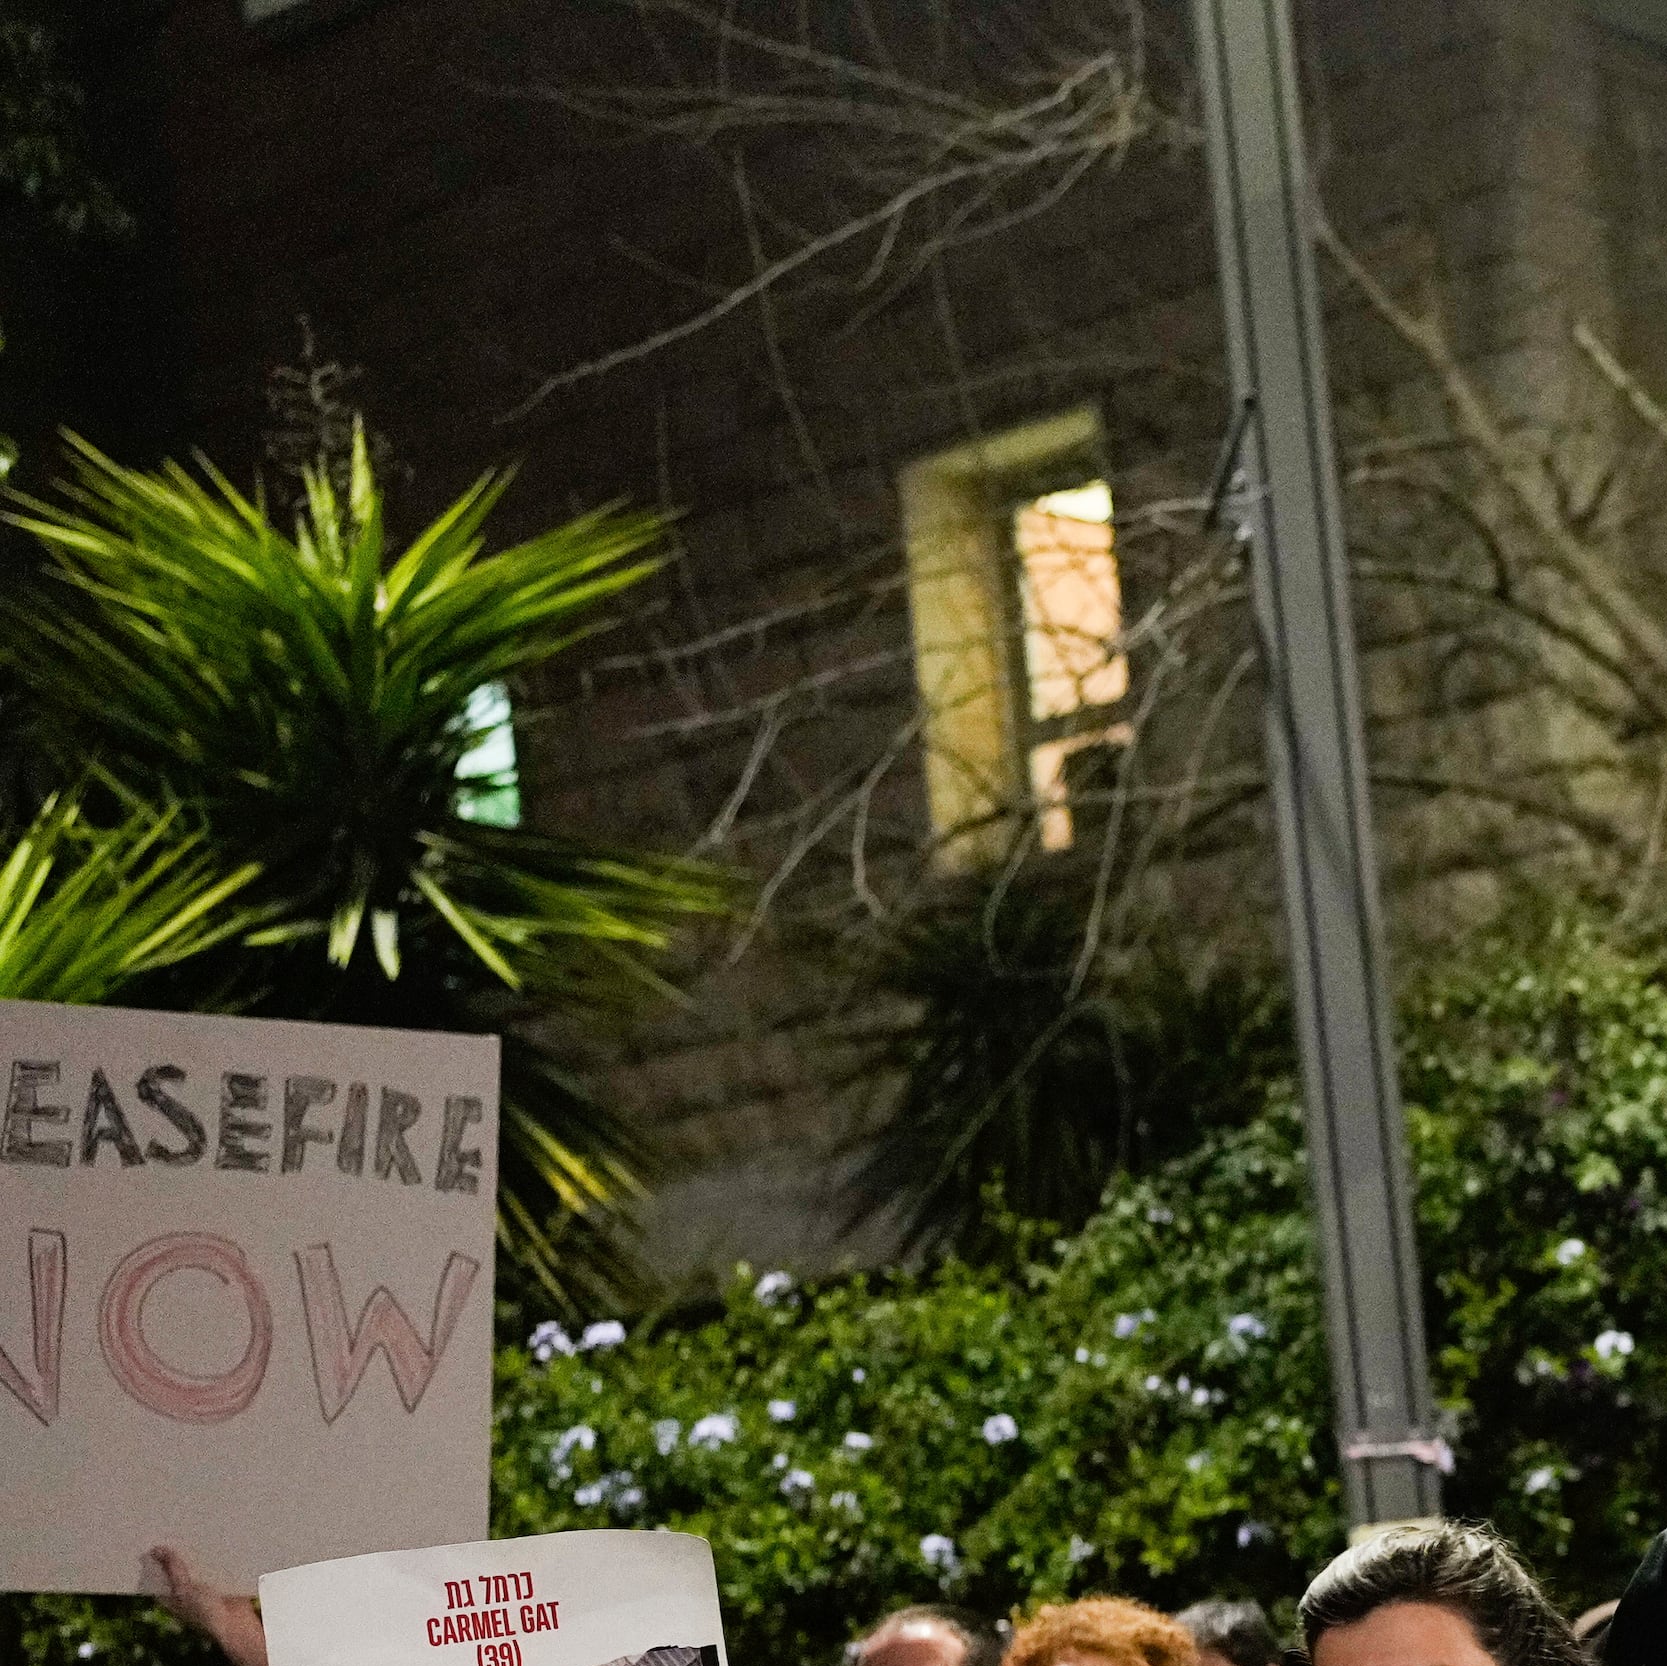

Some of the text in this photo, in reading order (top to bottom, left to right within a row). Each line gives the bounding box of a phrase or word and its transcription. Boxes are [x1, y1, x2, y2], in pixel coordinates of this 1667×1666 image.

[444, 1572, 534, 1610] כרמל גת
[426, 1601, 559, 1646] CARMEL GAT
